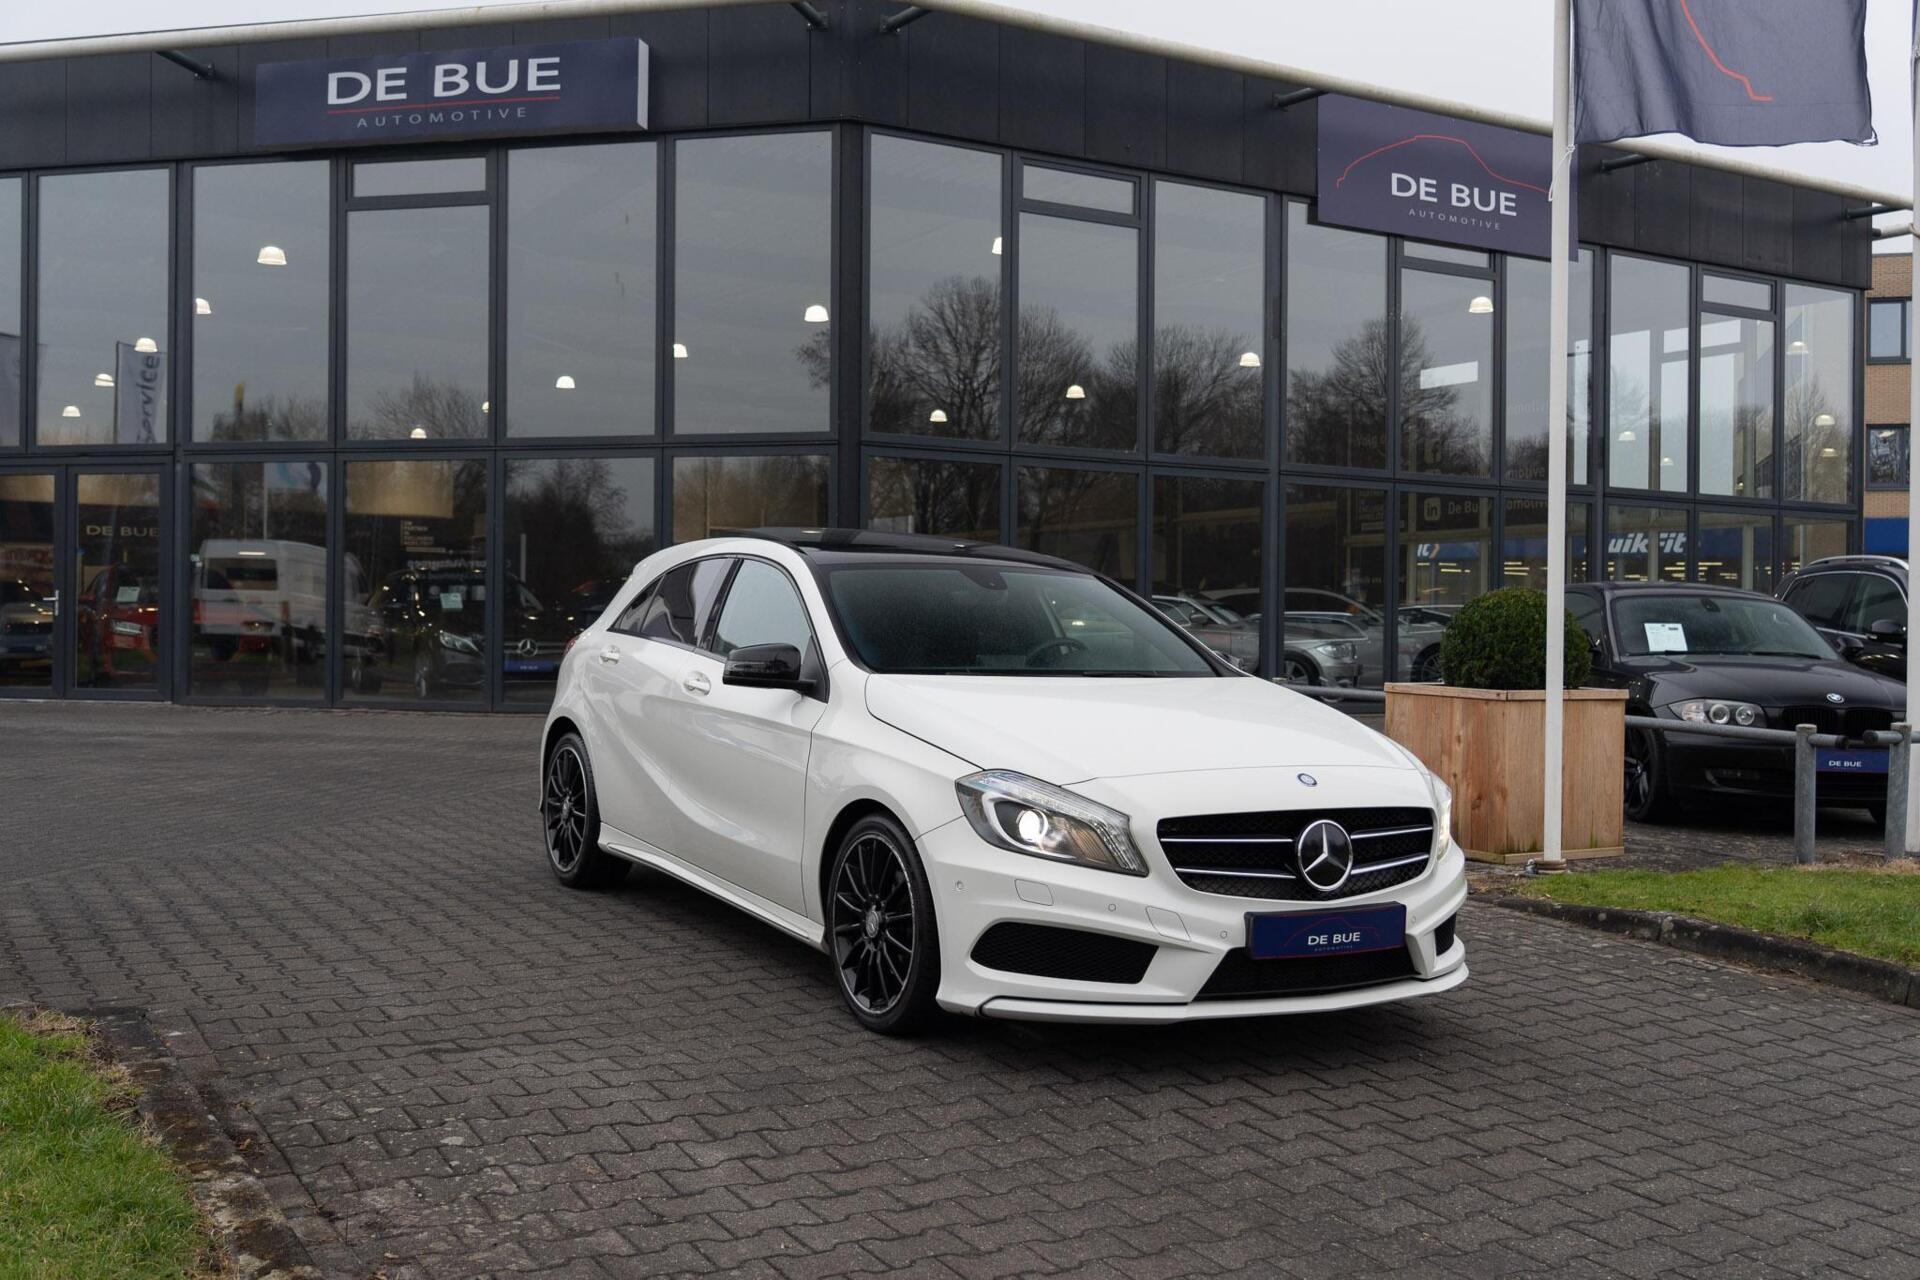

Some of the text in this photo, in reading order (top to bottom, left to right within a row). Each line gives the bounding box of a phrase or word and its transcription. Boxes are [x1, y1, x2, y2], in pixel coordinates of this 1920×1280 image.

[327, 57, 561, 105] DE BUE
[356, 107, 528, 129] AUTOMOTIVE
[1391, 172, 1518, 217] DE BUE
[1408, 208, 1502, 231] AUTOMOTIVE
[86, 525, 113, 536] DE
[1307, 931, 1361, 946] DE BUE
